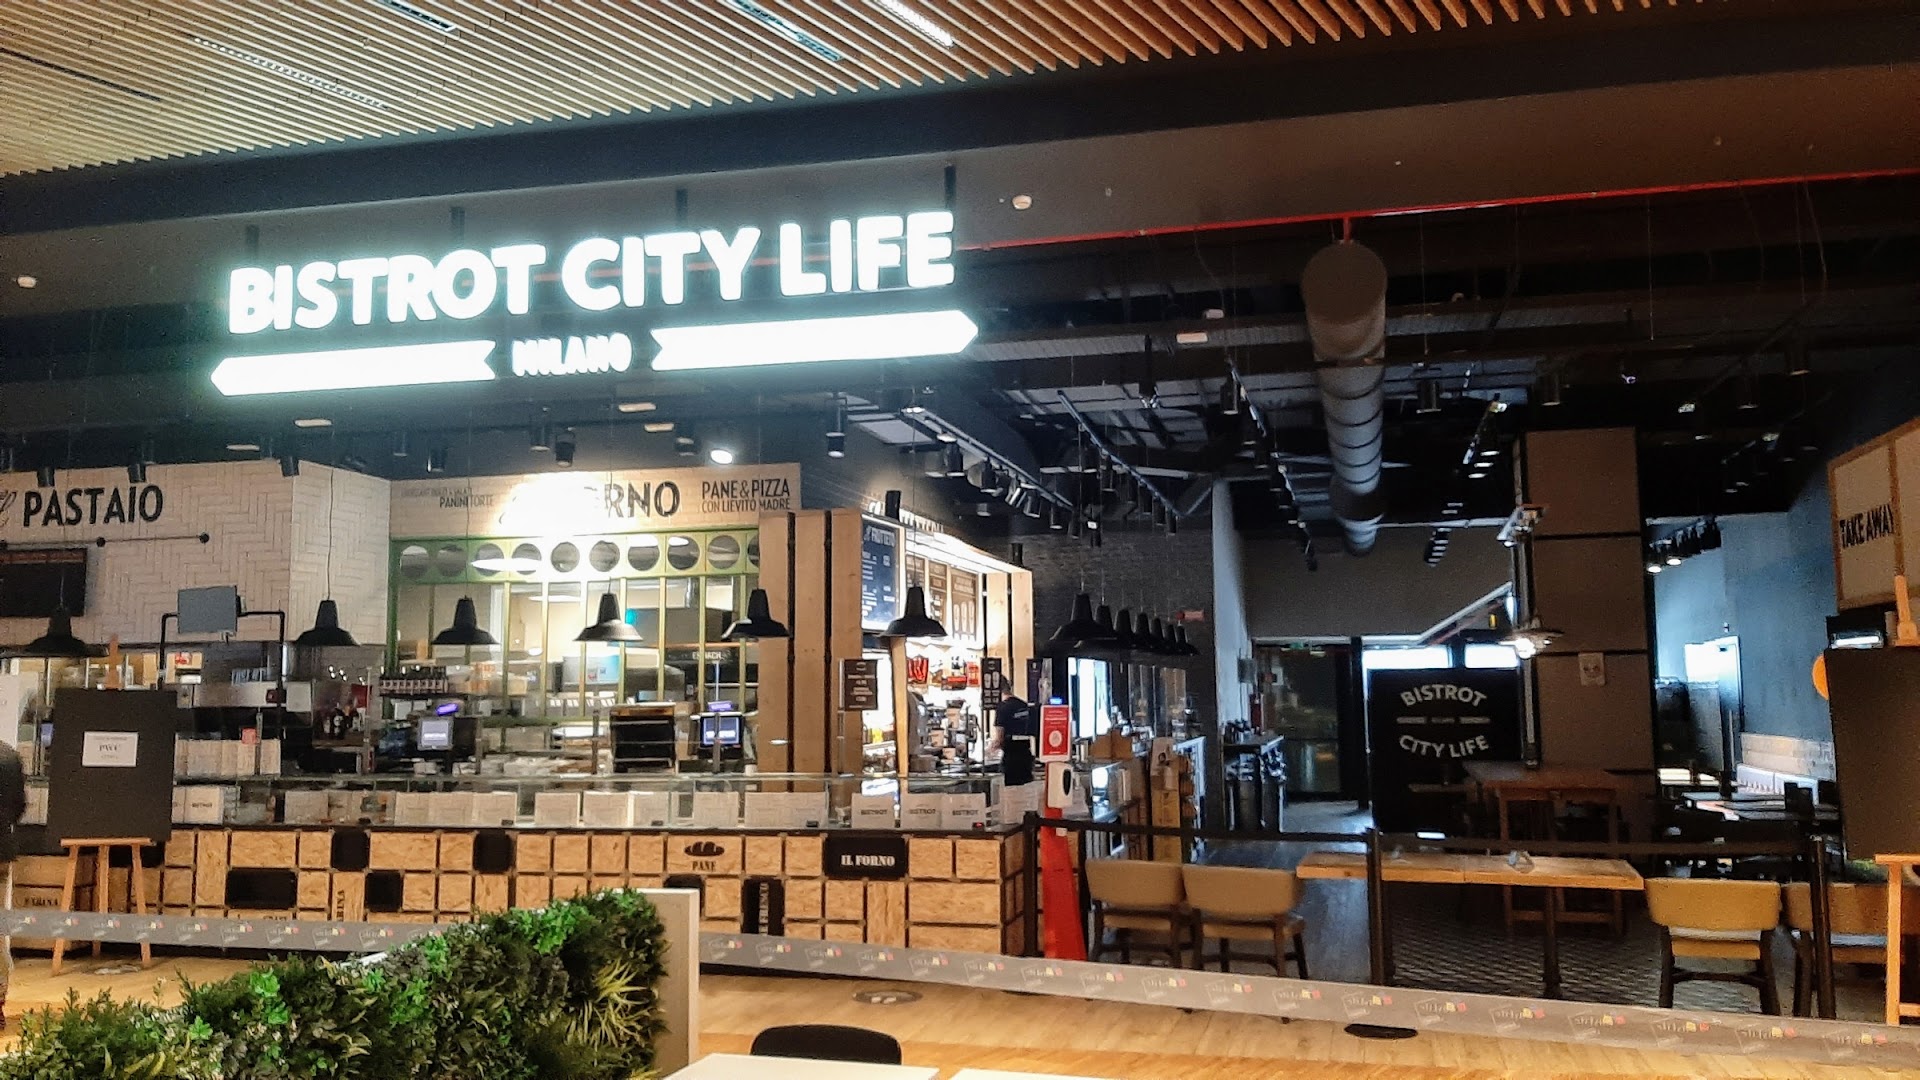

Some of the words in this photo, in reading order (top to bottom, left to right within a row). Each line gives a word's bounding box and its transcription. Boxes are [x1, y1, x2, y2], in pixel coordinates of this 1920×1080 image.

[228, 244, 547, 334] BISTROT
[561, 226, 761, 311] CITY
[779, 211, 955, 297] LIFE
[511, 331, 633, 378] MILANO
[22, 484, 165, 528] PASTAIO
[759, 498, 791, 511] MADRE
[1839, 512, 1865, 550] TAKE
[1400, 684, 1488, 707] BISTROT
[1399, 734, 1446, 758] CITY
[1448, 735, 1490, 758] LIFE
[692, 860, 717, 871] PANE
[840, 854, 853, 867] IL
[855, 854, 896, 867] FORNO
